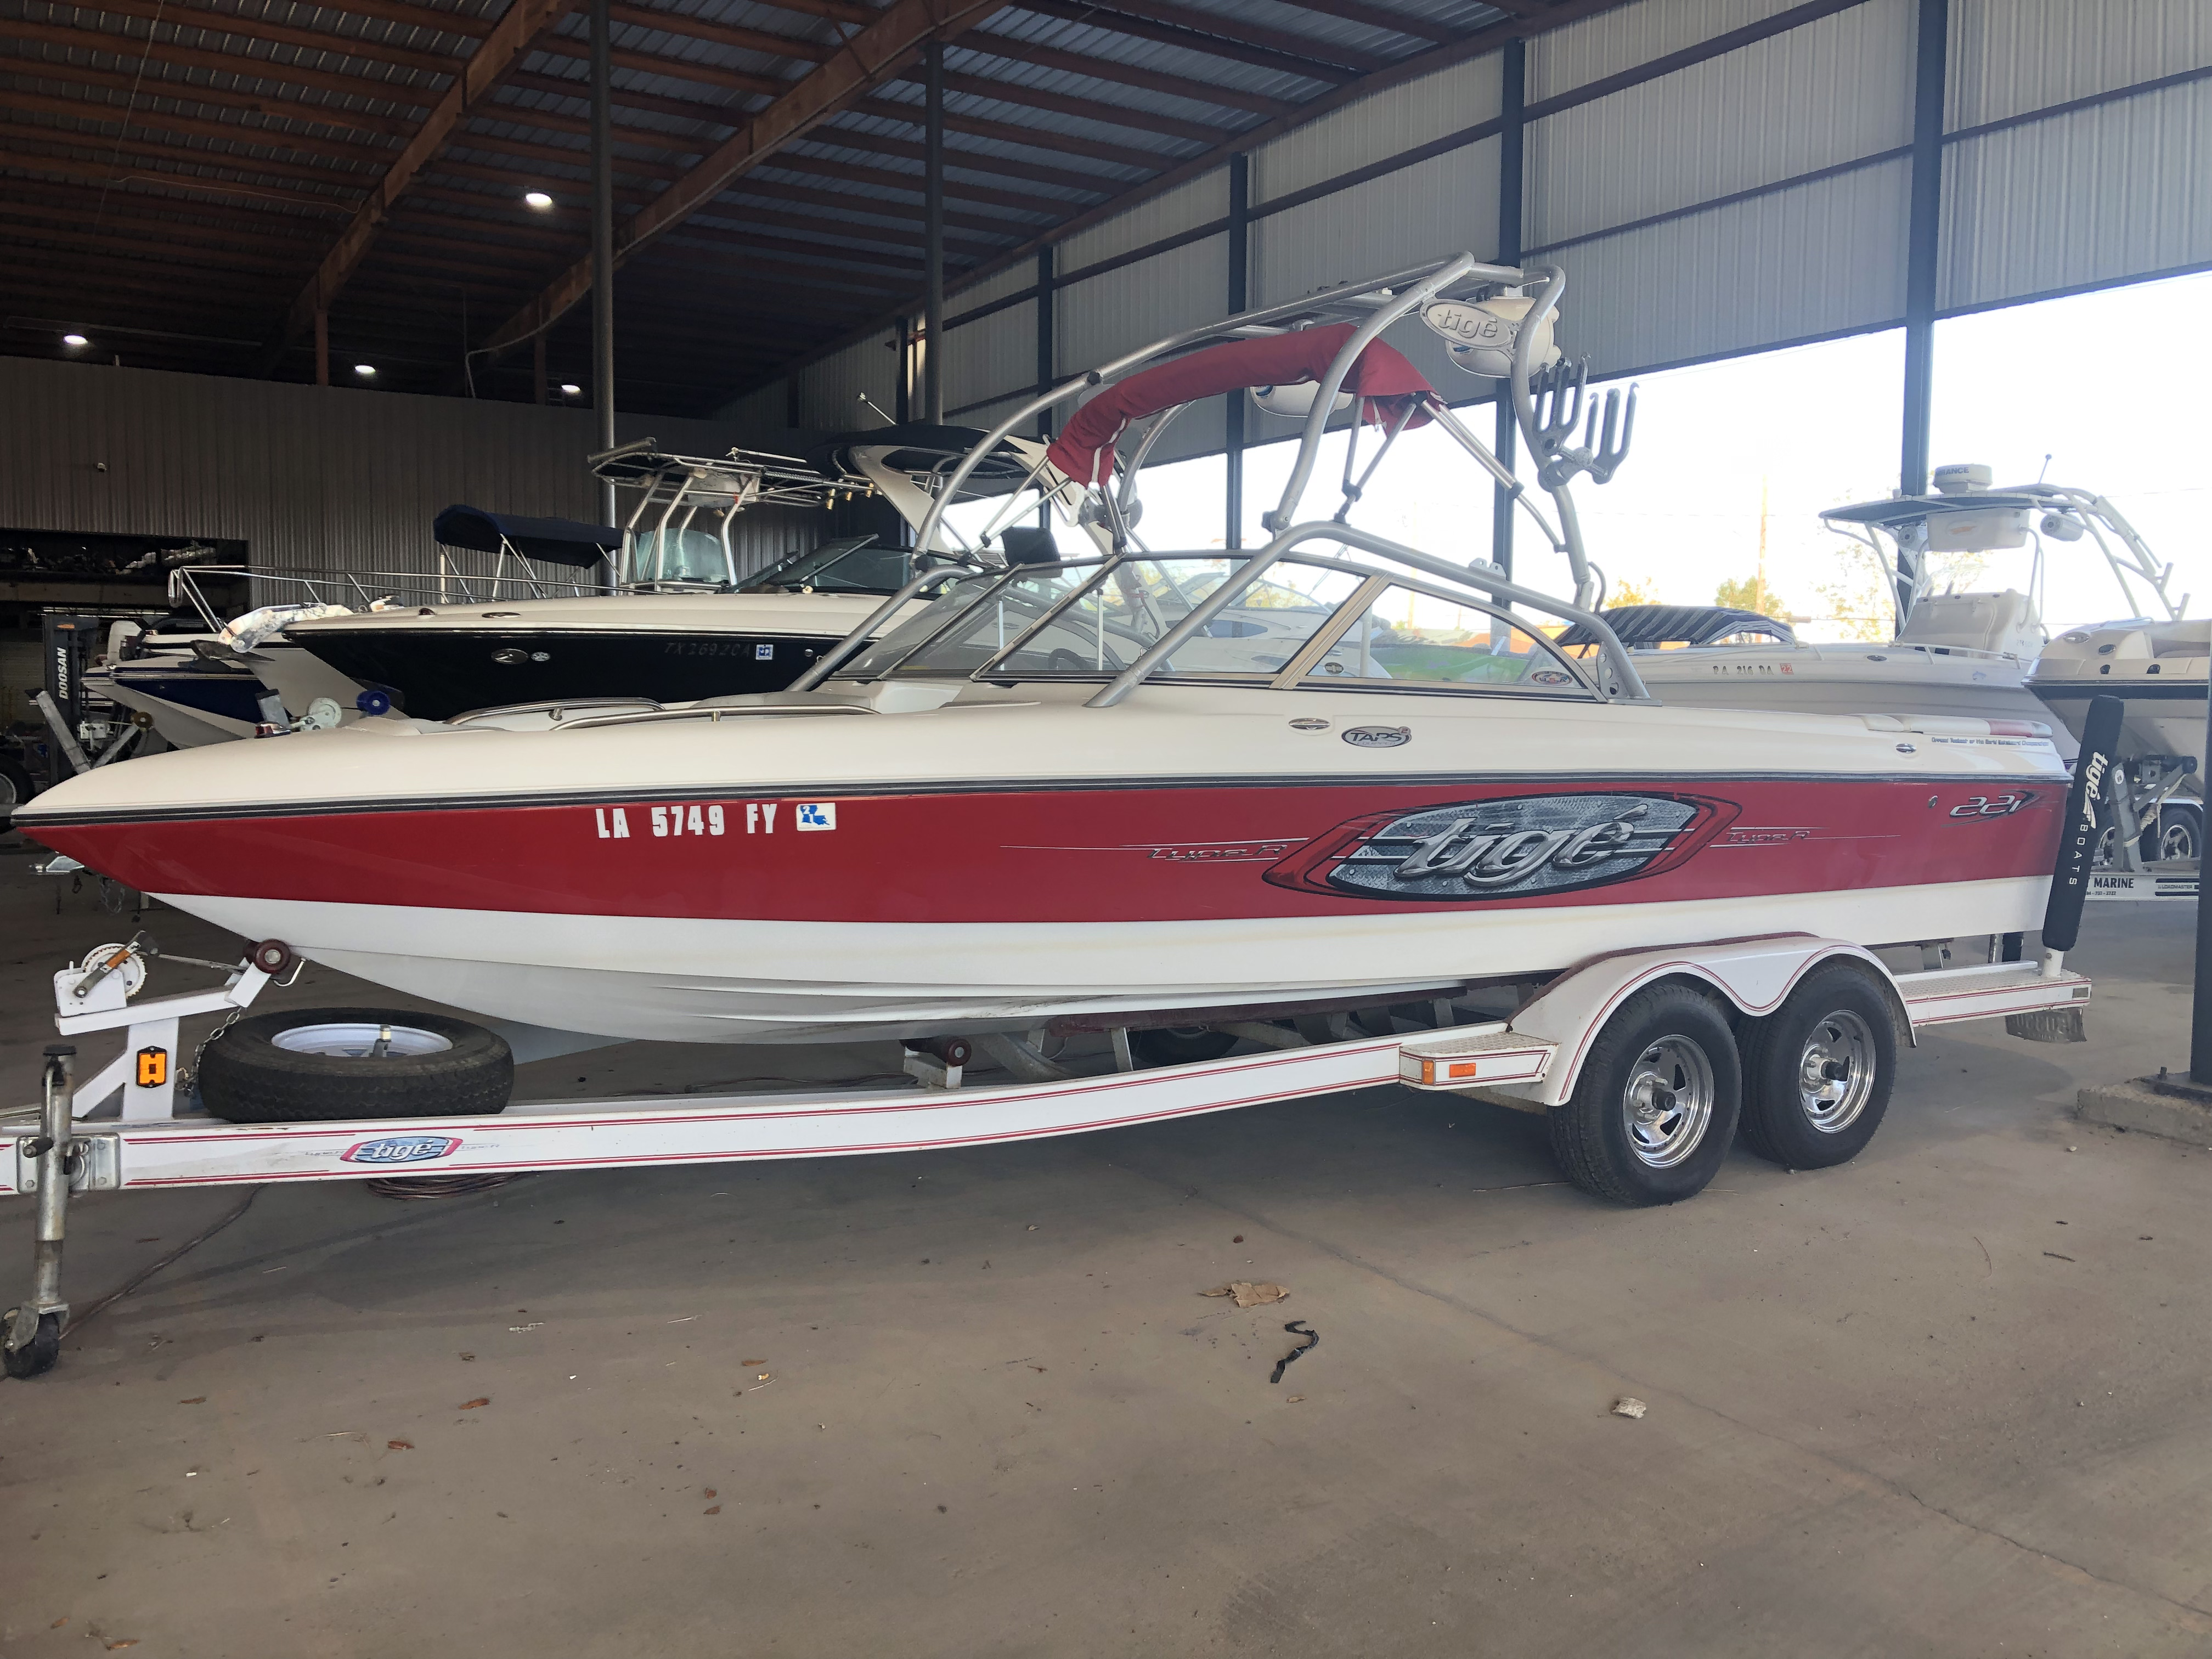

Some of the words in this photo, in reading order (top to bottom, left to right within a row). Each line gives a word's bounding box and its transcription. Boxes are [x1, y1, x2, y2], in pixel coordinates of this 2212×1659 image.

[1437, 309, 1498, 339] tigé
[57, 647, 68, 699] DOOSAN
[1350, 732, 1402, 742] TAPS
[2085, 751, 2109, 800] tigé
[595, 808, 630, 838] LA
[651, 804, 725, 837] 5749
[746, 803, 777, 834] FY
[1393, 803, 1649, 887] tigé
[2069, 823, 2089, 885] BOATS
[2094, 877, 2134, 889] MARINE
[371, 1139, 434, 1160] tigé
